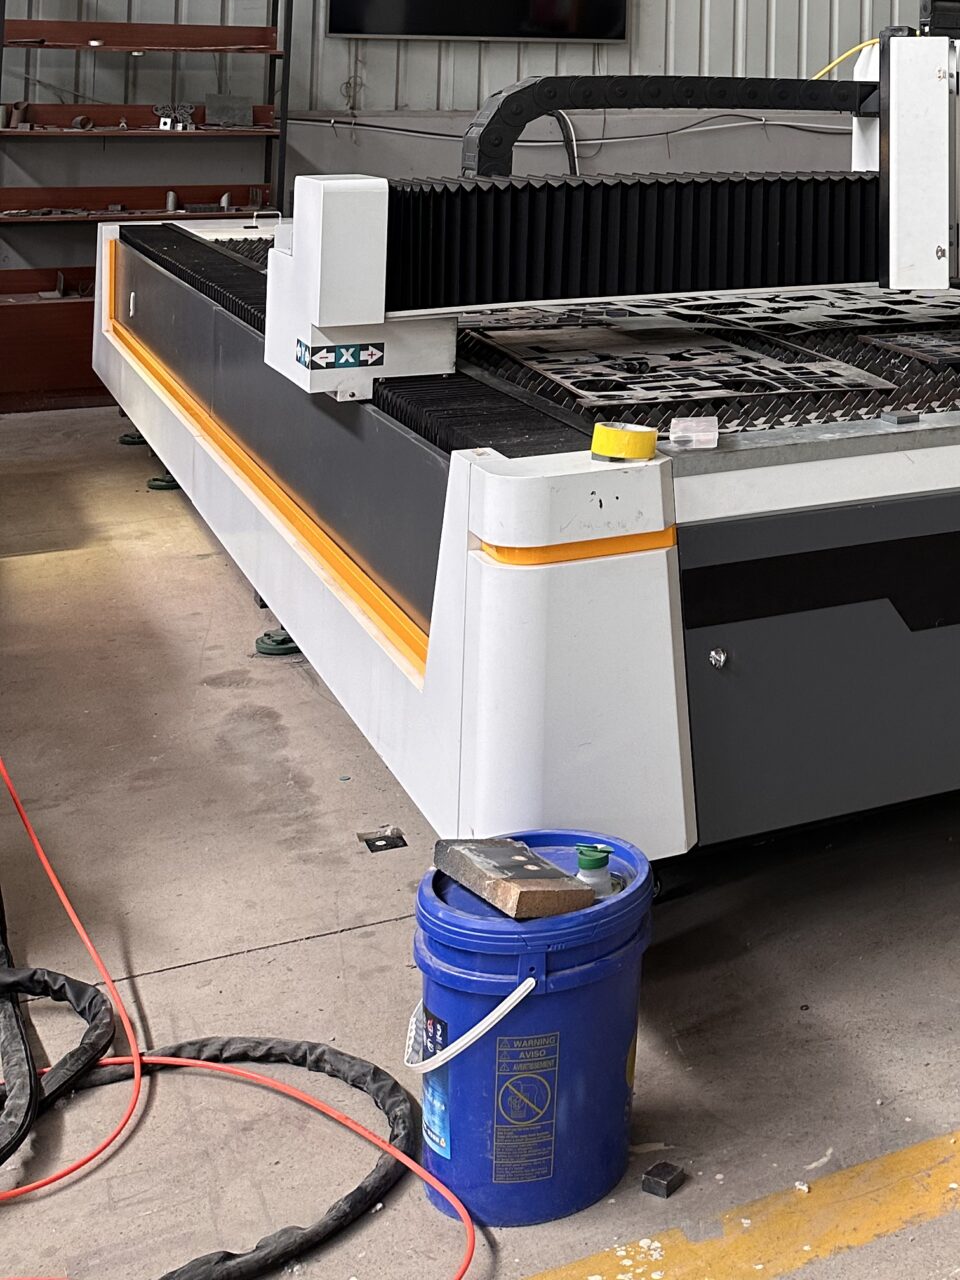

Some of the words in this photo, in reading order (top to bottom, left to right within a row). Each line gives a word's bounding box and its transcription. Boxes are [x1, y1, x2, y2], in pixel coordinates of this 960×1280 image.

[338, 347, 356, 364] X
[513, 1037, 556, 1048] WARNING
[518, 1049, 546, 1060] AVISO
